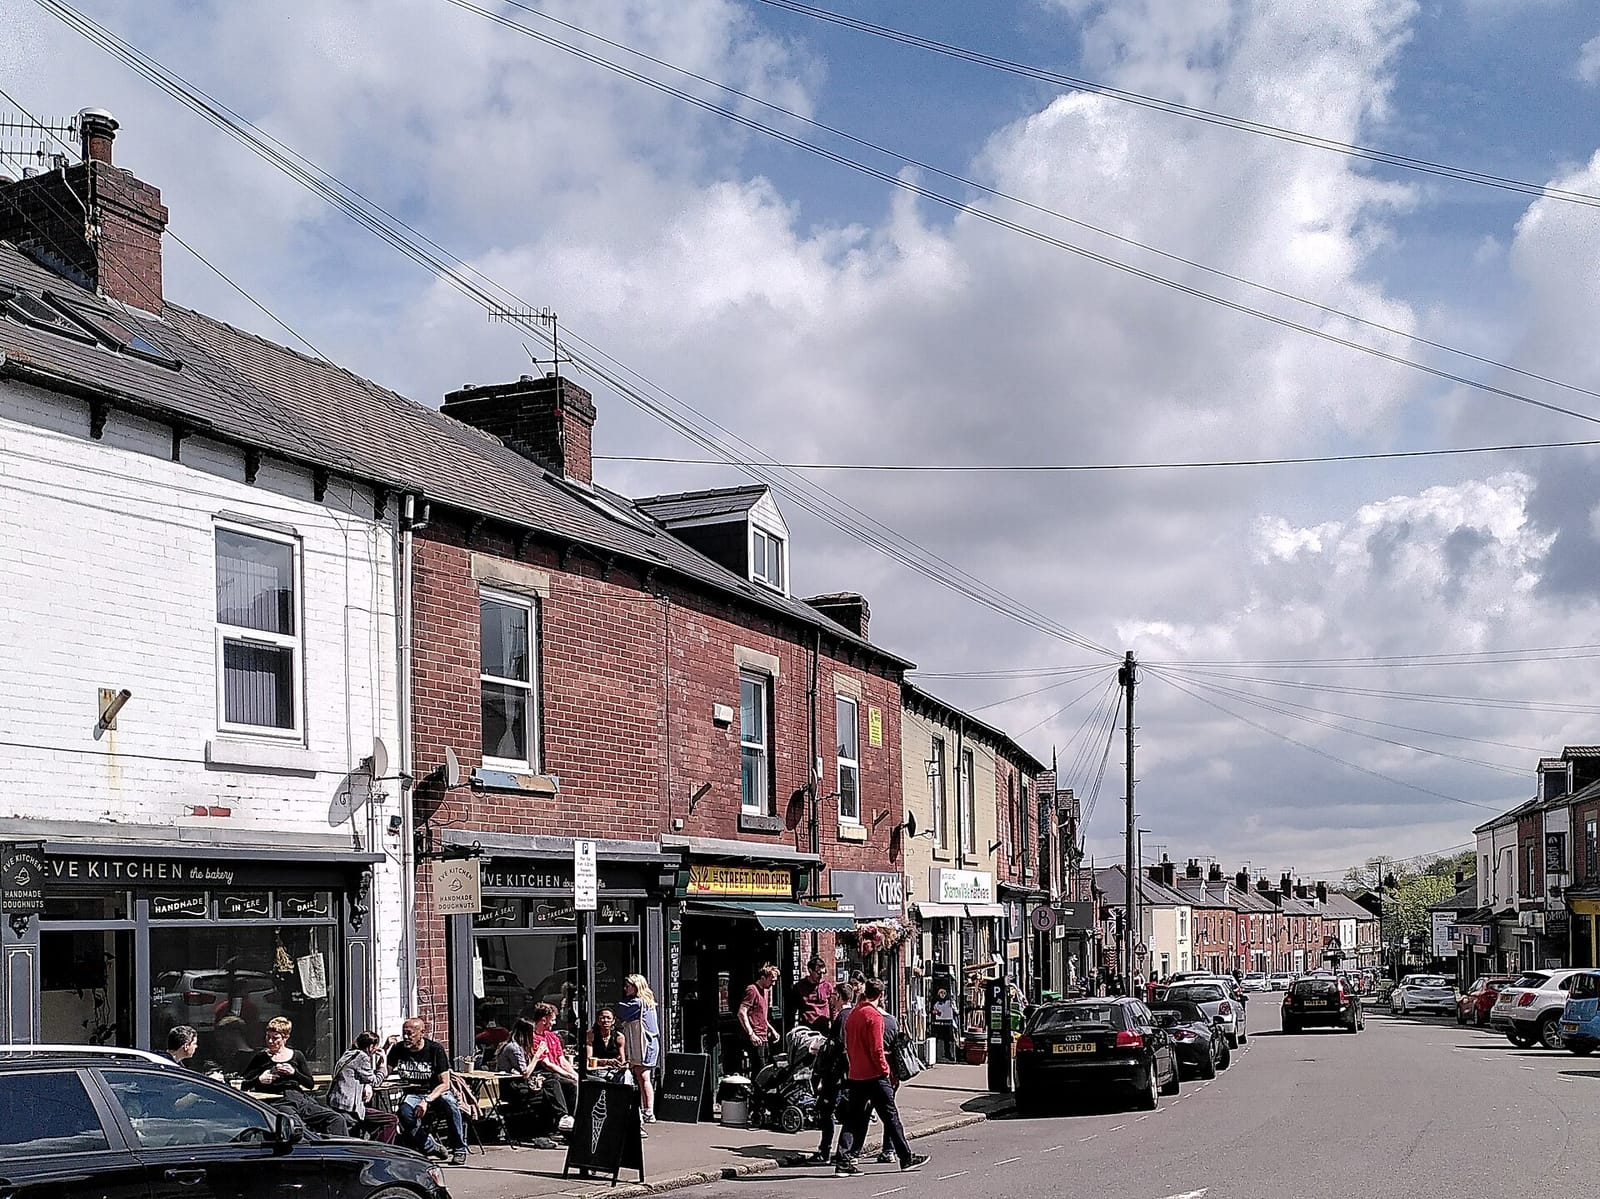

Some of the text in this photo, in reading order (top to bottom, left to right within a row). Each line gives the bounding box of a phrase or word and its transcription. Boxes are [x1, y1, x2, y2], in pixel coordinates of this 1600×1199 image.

[2, 854, 43, 873] EVE KITCHEN
[88, 861, 182, 879] KITCHEN
[189, 866, 204, 879] the
[205, 867, 234, 885] bakery
[438, 867, 473, 882] EVE KITCHEN
[506, 874, 560, 887] KITCHEN
[719, 869, 749, 889] STREET
[751, 870, 770, 889] FOOD
[771, 871, 789, 890] CHEF
[4, 890, 42, 898] HANDMADE
[440, 894, 473, 902] HANDMADE
[3, 900, 44, 908] DOUGHNUTS
[155, 898, 203, 913] HANDMADE
[231, 904, 241, 912] IN
[297, 900, 318, 911] DAILY
[438, 902, 475, 910] DOUGHNUTS
[478, 911, 493, 921] TAKE
[500, 906, 515, 914] SEAT
[601, 905, 614, 923] Way
[993, 986, 1001, 998] P
[663, 1093, 698, 1102] DOUGHNUTS
